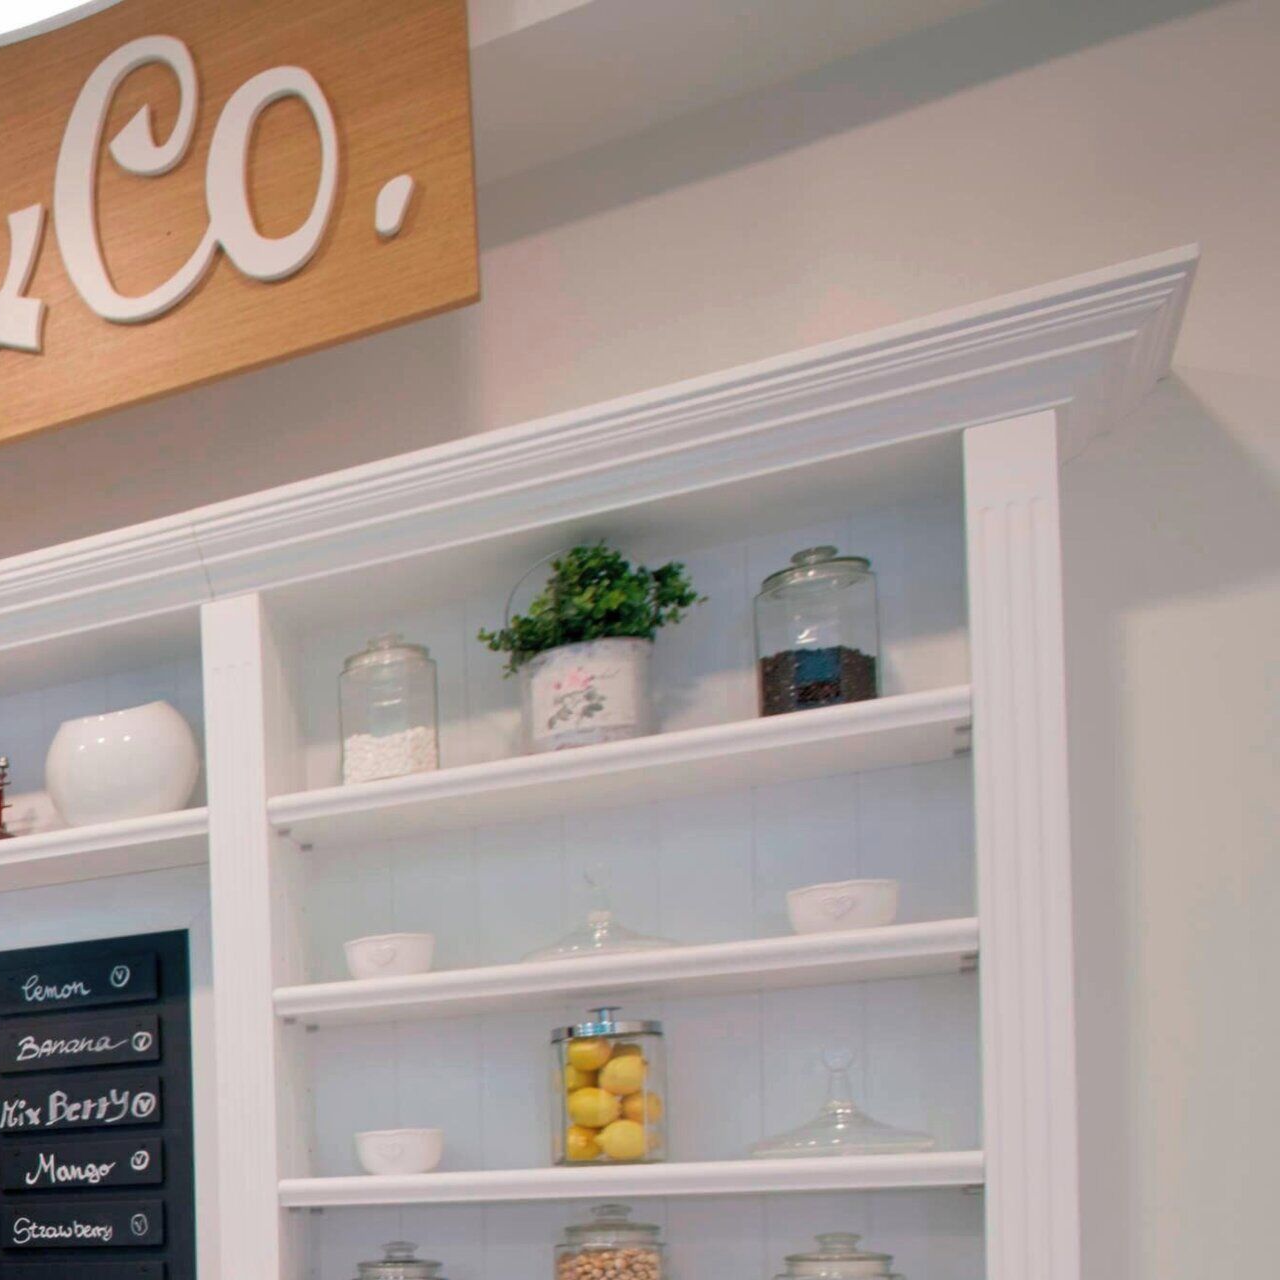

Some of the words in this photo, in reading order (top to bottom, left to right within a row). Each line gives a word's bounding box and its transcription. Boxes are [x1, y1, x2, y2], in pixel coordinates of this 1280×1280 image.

[0, 1099, 41, 1130] Mix
[45, 1088, 129, 1127] Berry
[25, 1153, 116, 1186] Mango
[13, 1217, 113, 1245] Strawberry
